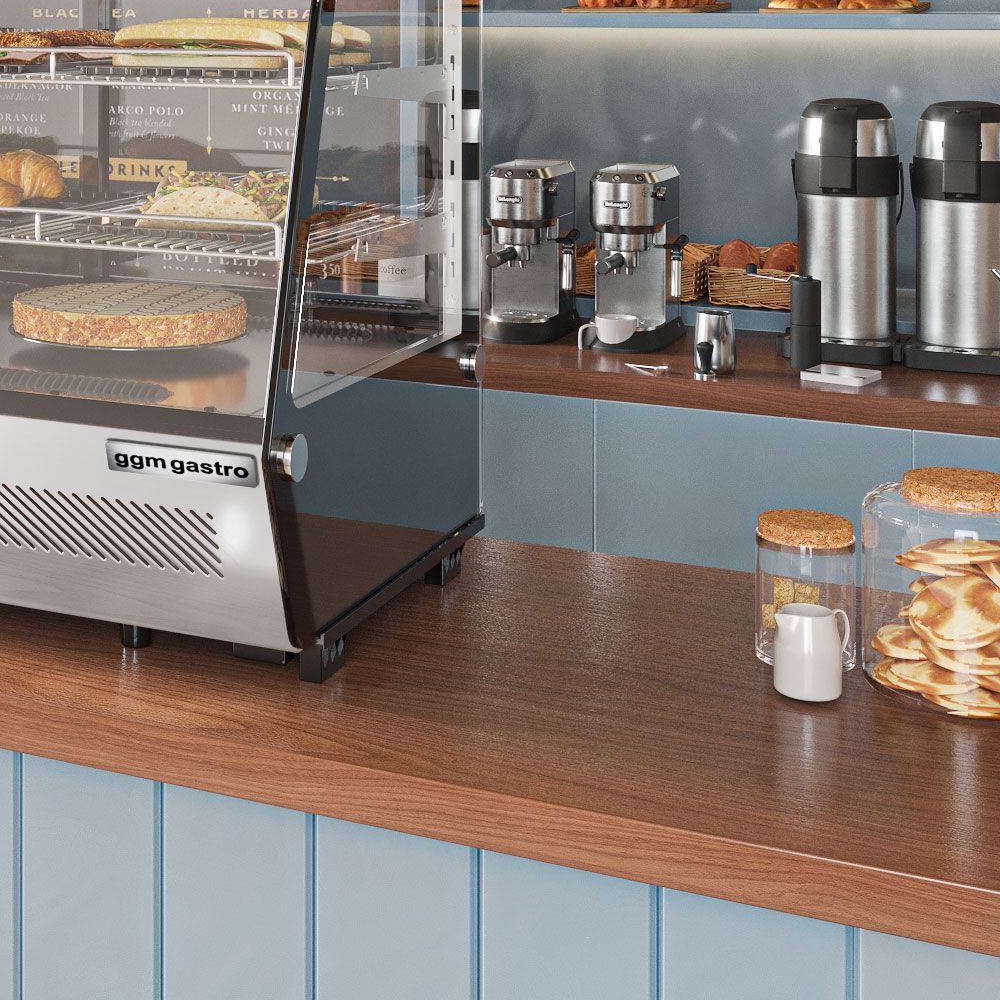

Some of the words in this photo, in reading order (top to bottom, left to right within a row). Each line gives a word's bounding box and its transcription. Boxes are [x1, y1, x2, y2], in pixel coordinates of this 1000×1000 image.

[32, 8, 79, 19] BLAC
[111, 8, 137, 19] EA
[243, 8, 312, 19] HERBA
[252, 91, 300, 101] ORGAN
[108, 104, 144, 116] ARCO
[149, 106, 184, 117] POLO
[232, 103, 266, 114] MINT
[1, 125, 41, 136] PEKOE
[257, 126, 295, 137] GING
[264, 140, 293, 151] TWI
[114, 452, 167, 470] ggm
[170, 459, 249, 479] gastro
